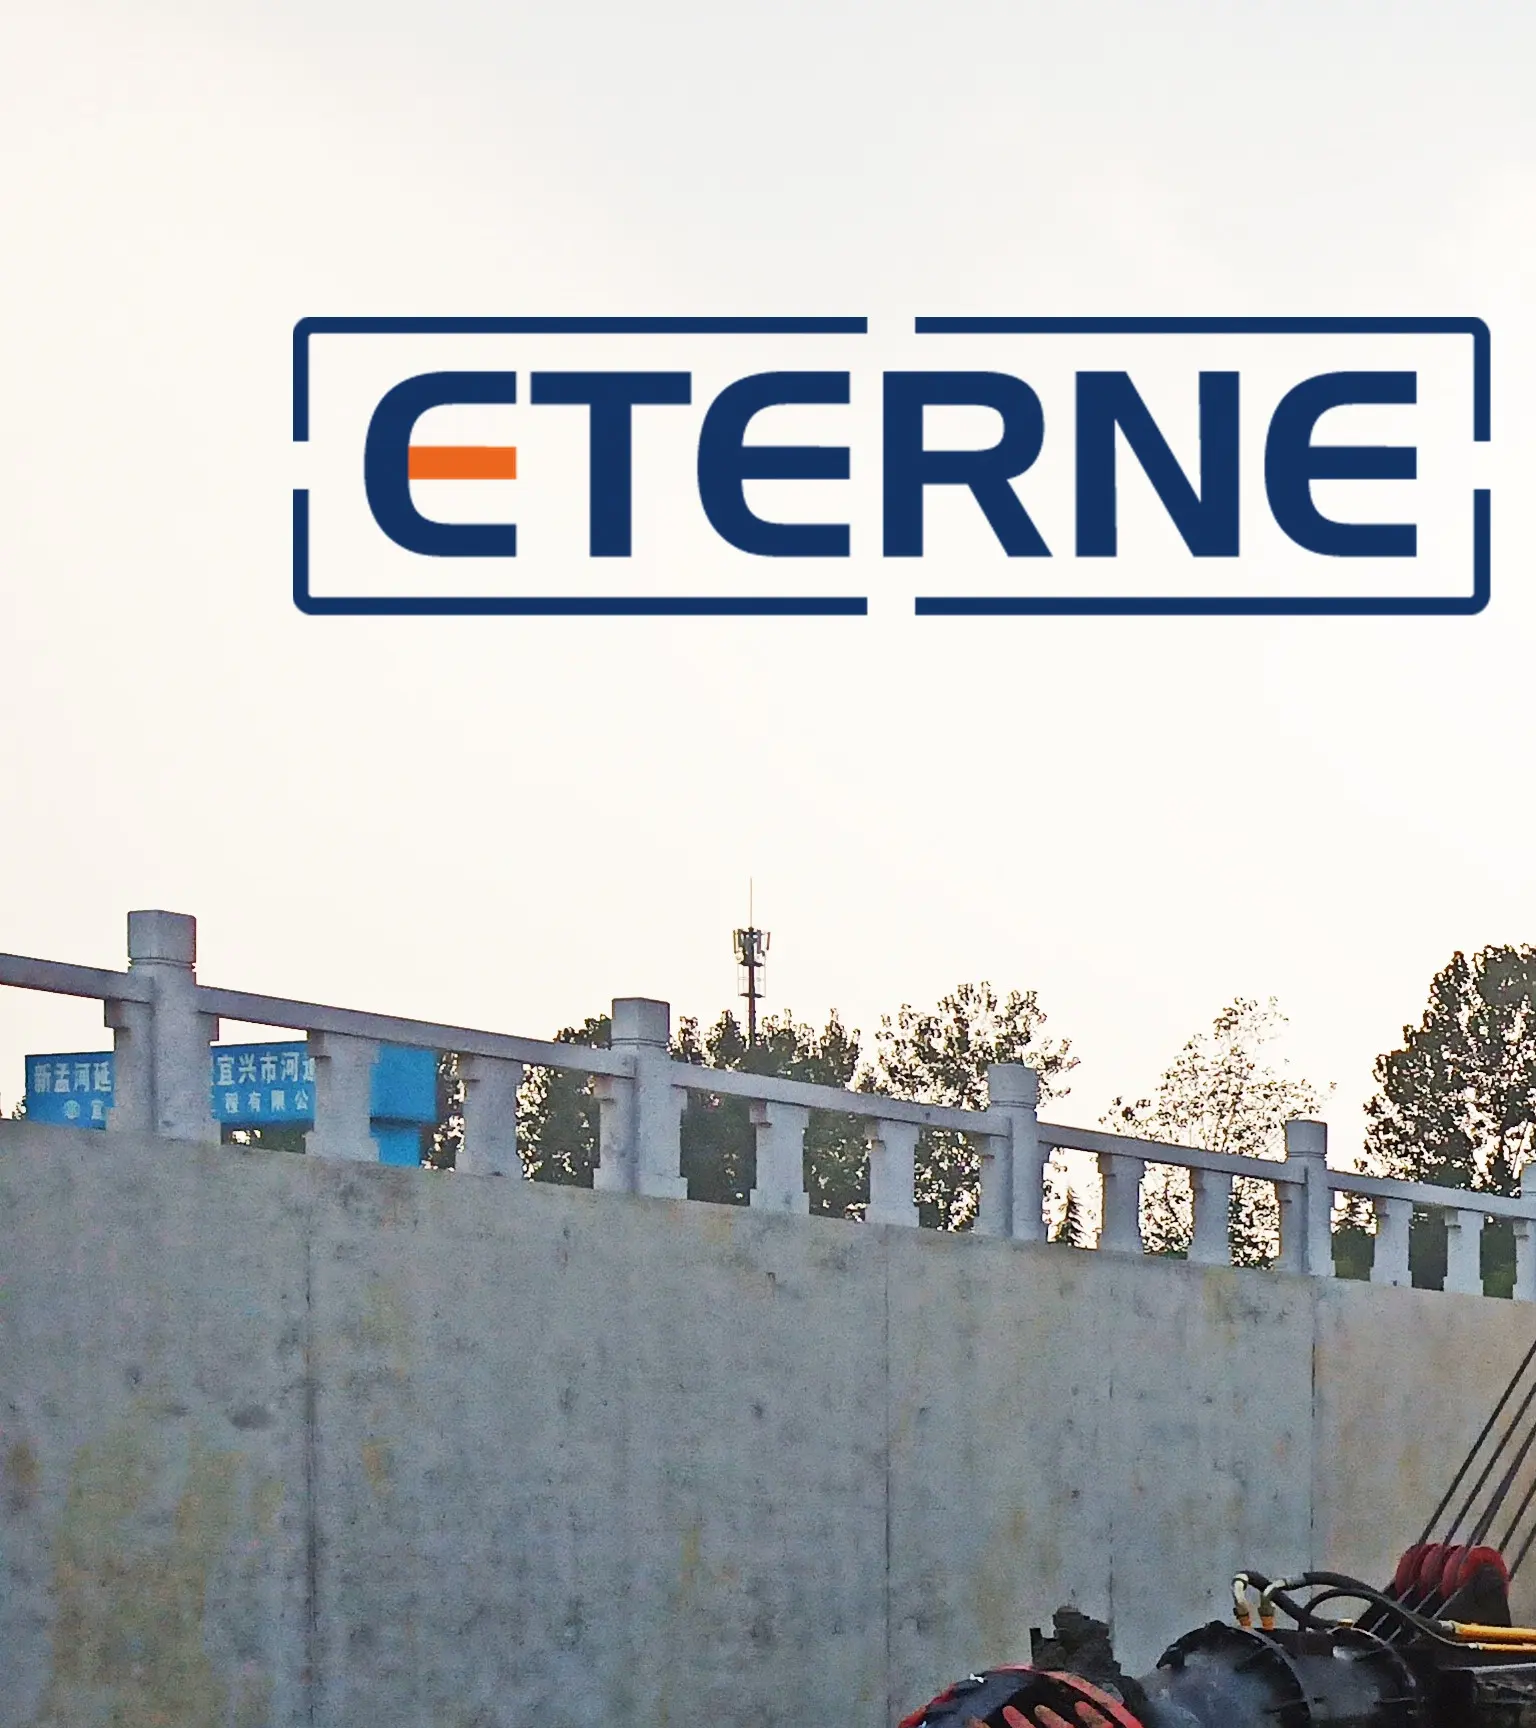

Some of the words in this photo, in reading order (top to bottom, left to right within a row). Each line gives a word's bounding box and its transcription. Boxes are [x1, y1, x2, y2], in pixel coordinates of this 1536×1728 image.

[210, 1051, 316, 1086] 宜兴市河道
